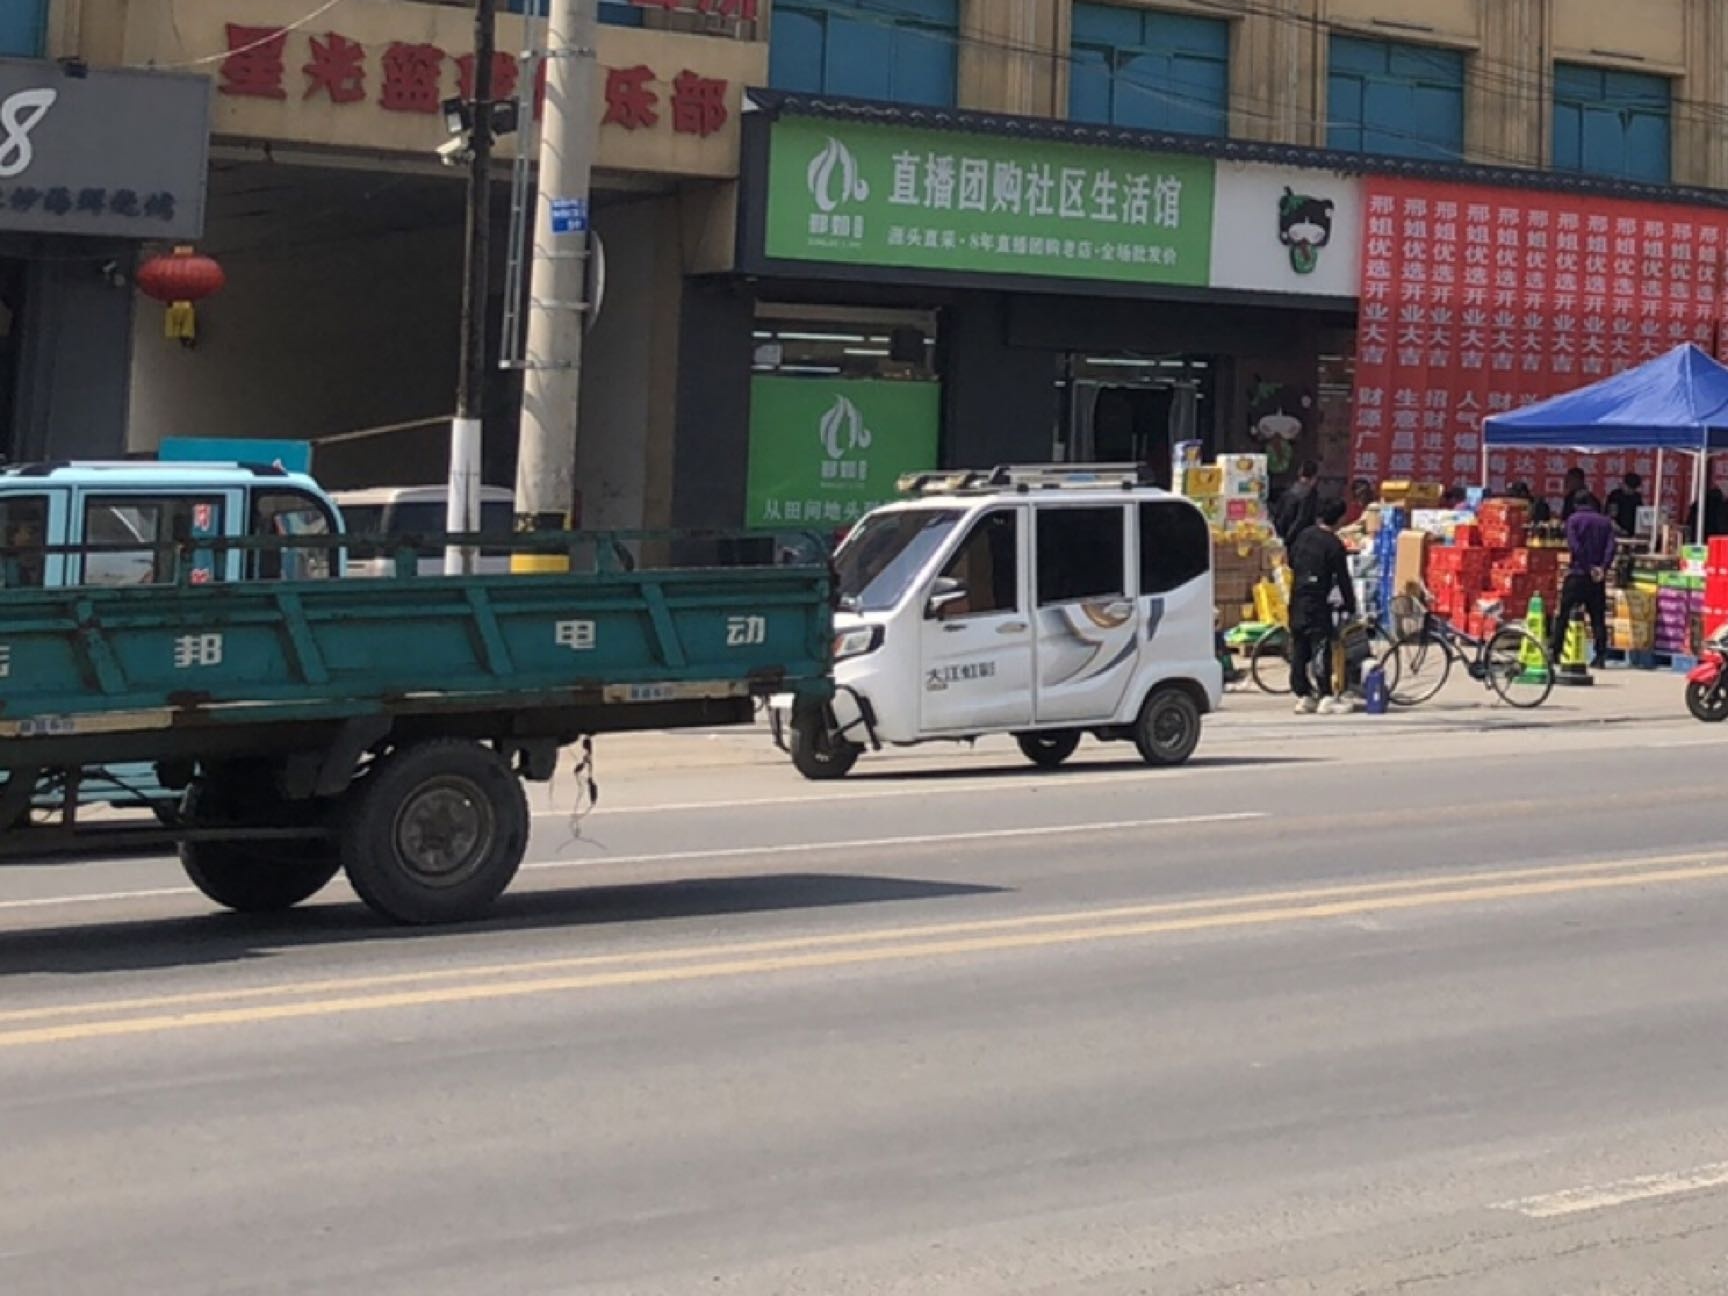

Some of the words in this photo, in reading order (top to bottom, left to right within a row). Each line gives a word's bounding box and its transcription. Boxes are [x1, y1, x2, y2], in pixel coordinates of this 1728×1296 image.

[888, 150, 1182, 229] 直播团购社区生活馆
[174, 633, 223, 669] 邦
[555, 619, 596, 649] 电
[726, 615, 766, 646] 动
